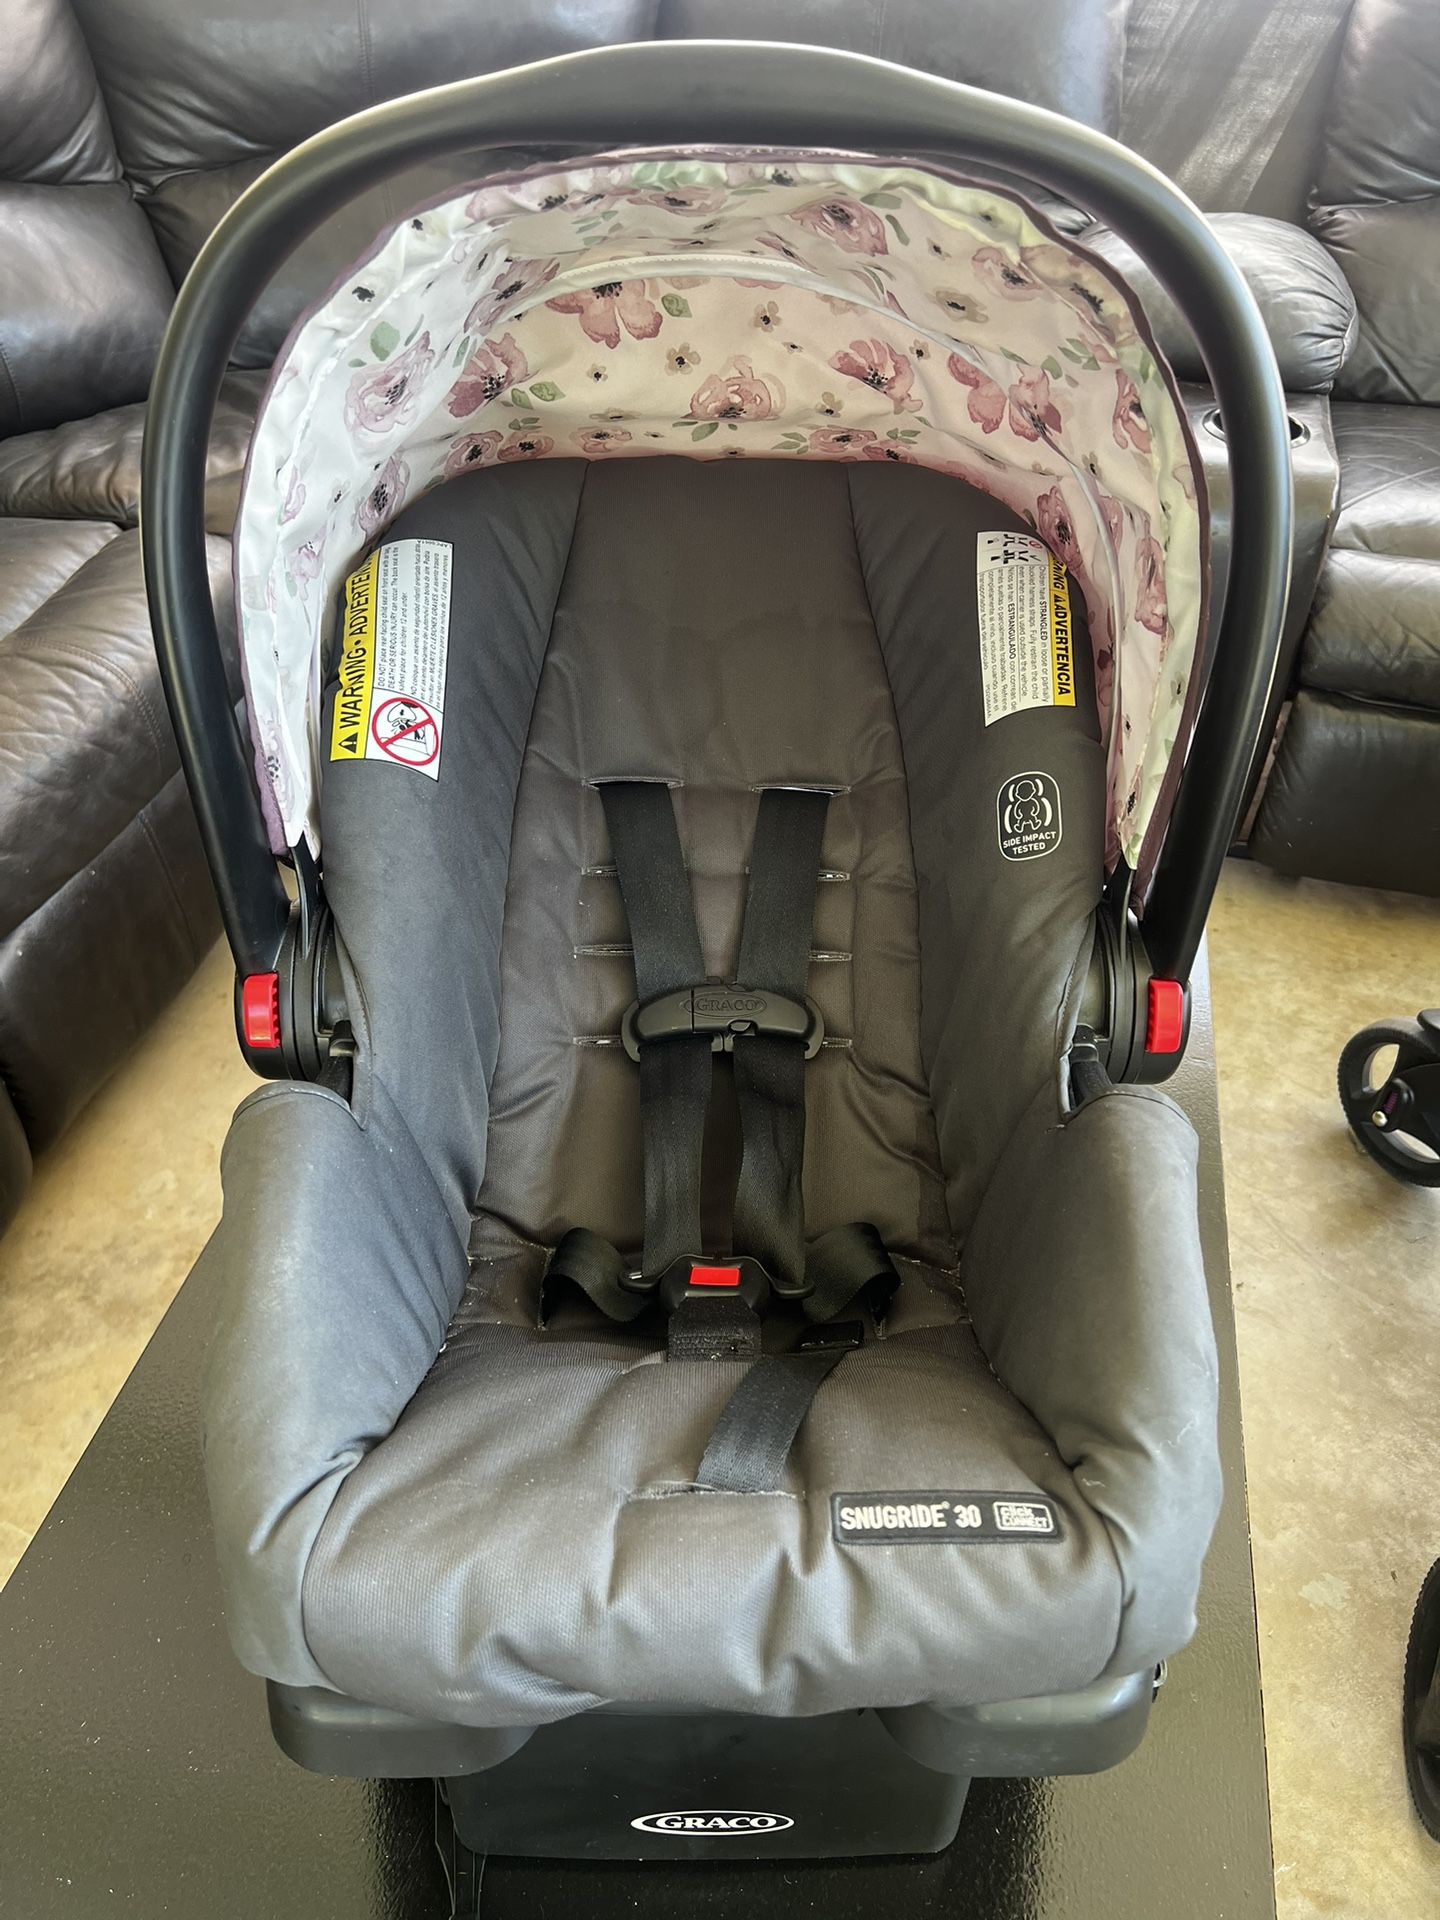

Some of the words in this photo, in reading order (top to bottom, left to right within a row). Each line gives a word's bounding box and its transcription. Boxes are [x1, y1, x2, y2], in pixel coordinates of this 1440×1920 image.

[1039, 566, 1047, 586] Children
[390, 612, 398, 631] INJURY
[1019, 620, 1027, 635] used
[1039, 601, 1048, 640] STRANGLED
[430, 616, 438, 644] LESIONES
[1008, 603, 1016, 660] ESTRANGULADO
[1029, 629, 1038, 644] Fully
[389, 632, 397, 657] SERIOUS
[1053, 604, 1070, 695] ADVERTENCIA
[379, 648, 388, 663] place
[388, 657, 396, 667] OR
[378, 663, 386, 675] NOT
[378, 677, 385, 686] DO
[388, 668, 396, 689] DEATH
[339, 648, 367, 729] WARNING
[410, 686, 417, 695] NO
[1041, 677, 1049, 702] partially
[1011, 701, 1018, 711] de
[1003, 837, 1021, 848] SIDE
[1022, 831, 1056, 843] IMPACT
[1012, 842, 1046, 855] TESTED
[696, 998, 757, 1012] GRACO
[953, 1505, 982, 1528] 30
[656, 1816, 777, 1829] GRACO
